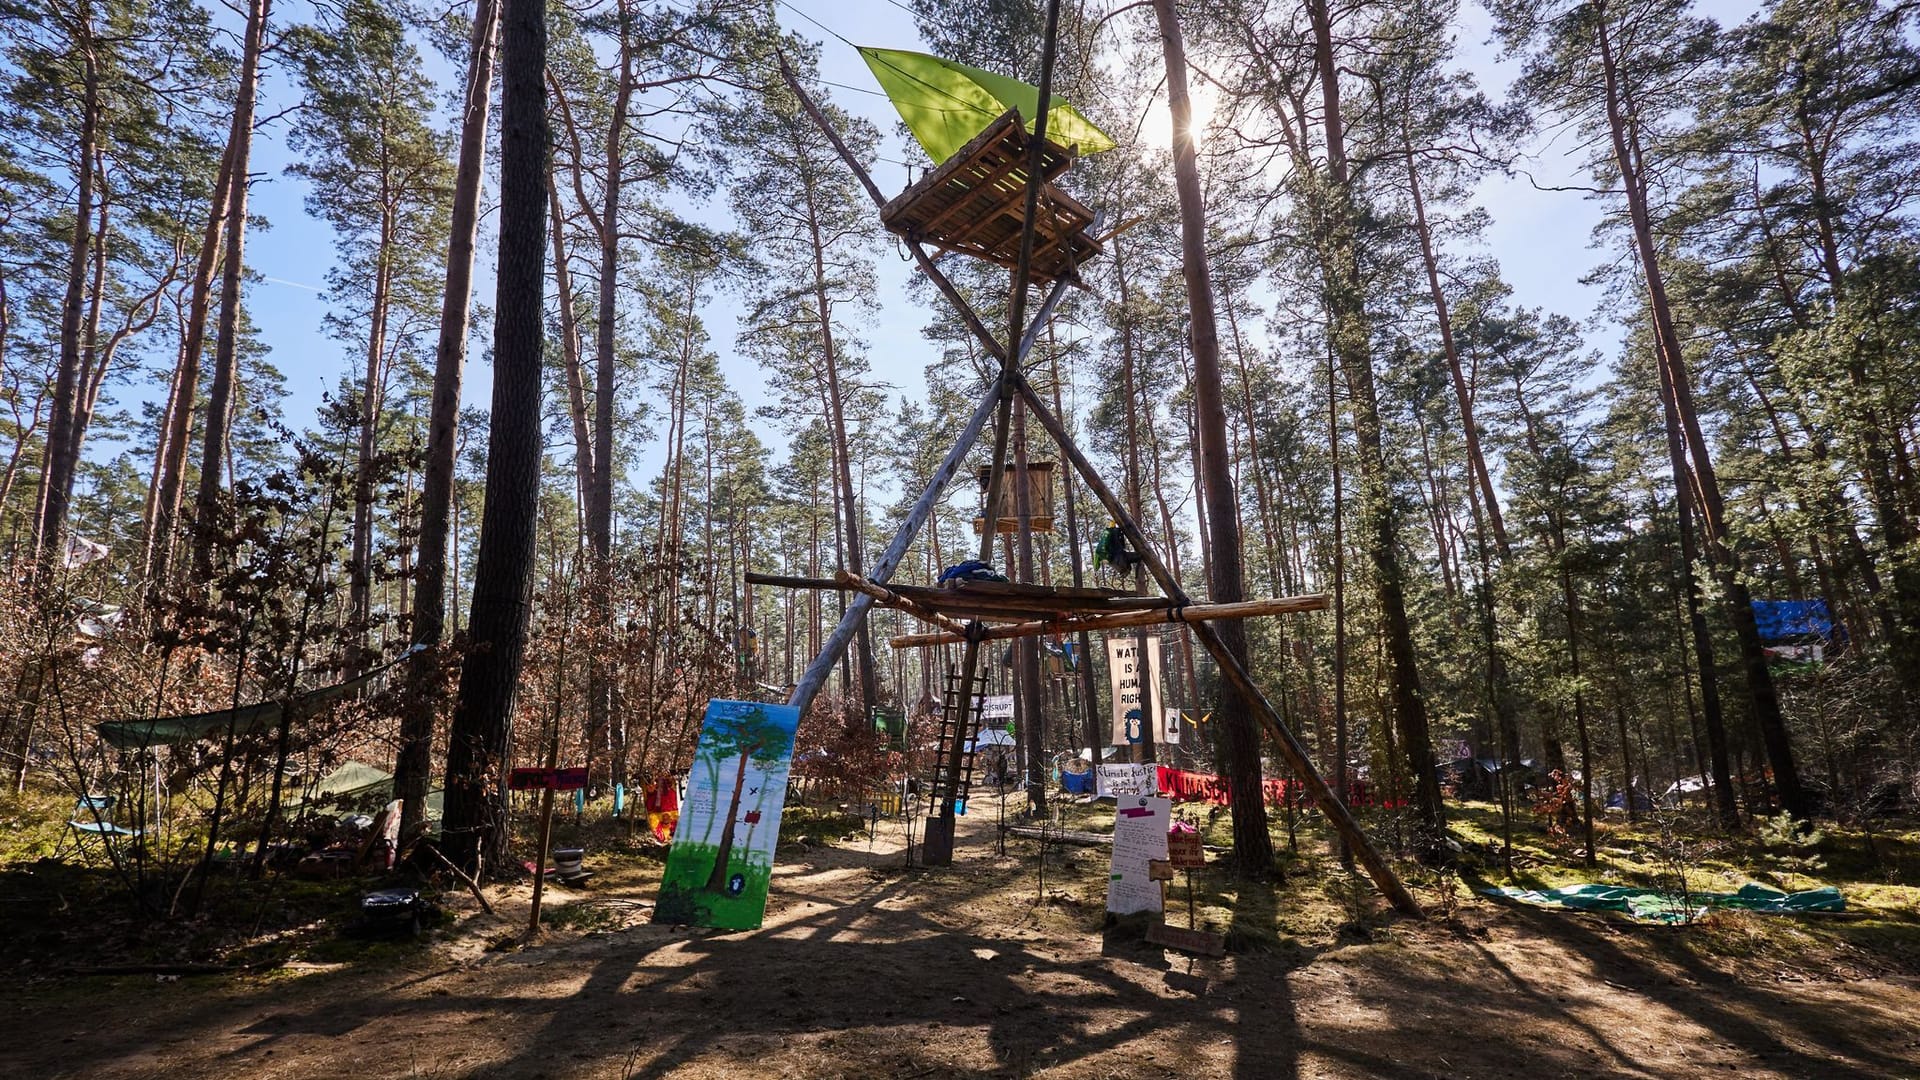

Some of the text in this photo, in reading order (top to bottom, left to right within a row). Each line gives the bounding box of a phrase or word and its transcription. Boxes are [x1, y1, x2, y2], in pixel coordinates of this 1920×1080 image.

[1116, 647, 1139, 658] WAT
[1125, 663, 1133, 673] IS
[1120, 679, 1141, 689] HUM
[1121, 693, 1141, 704] RIGH
